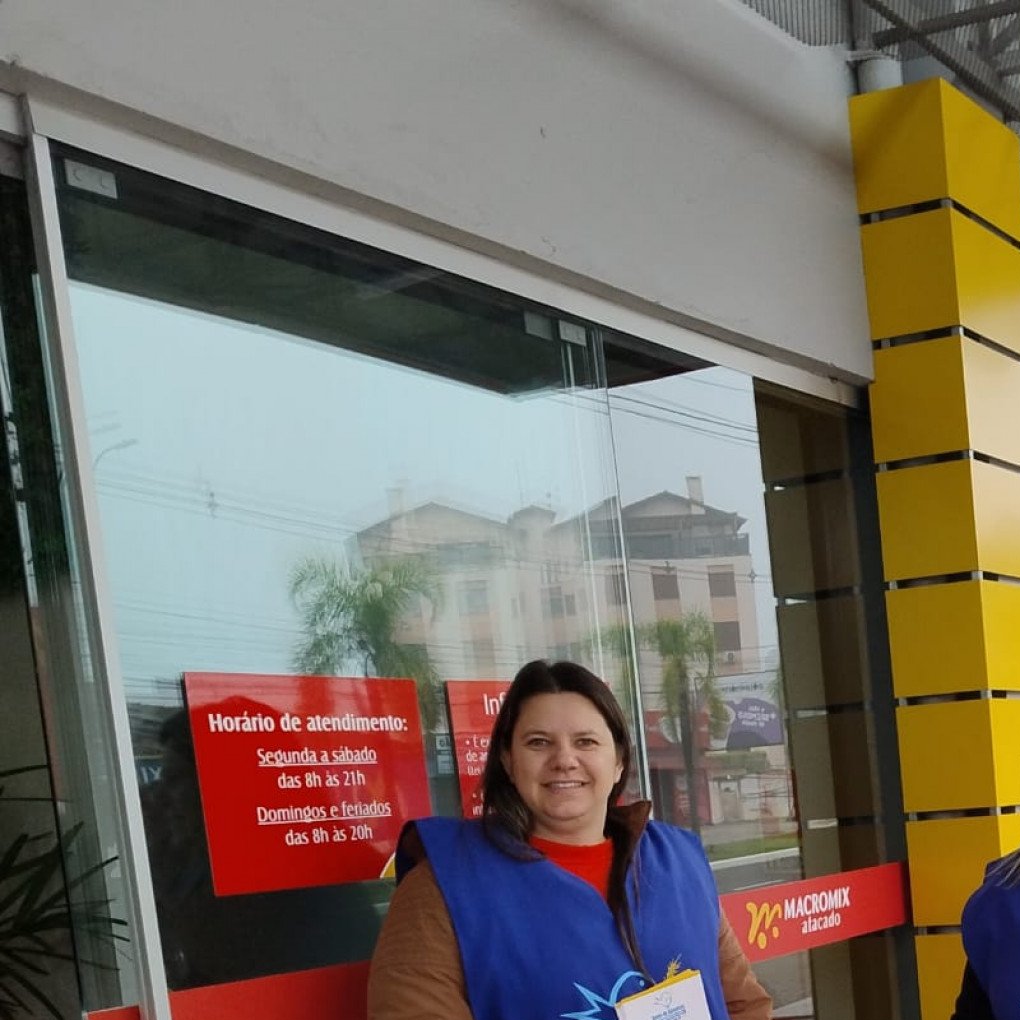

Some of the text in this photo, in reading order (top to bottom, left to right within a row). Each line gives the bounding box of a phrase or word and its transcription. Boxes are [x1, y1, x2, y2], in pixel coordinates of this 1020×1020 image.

[208, 712, 408, 733] Horário de atendimento:
[256, 745, 377, 768] Segunda a sábado
[277, 770, 366, 789] das 8h às 21h
[256, 801, 391, 825] Domingos e feriados
[285, 825, 373, 845] das 8h às 20h
[784, 886, 850, 920] MACROMIX
